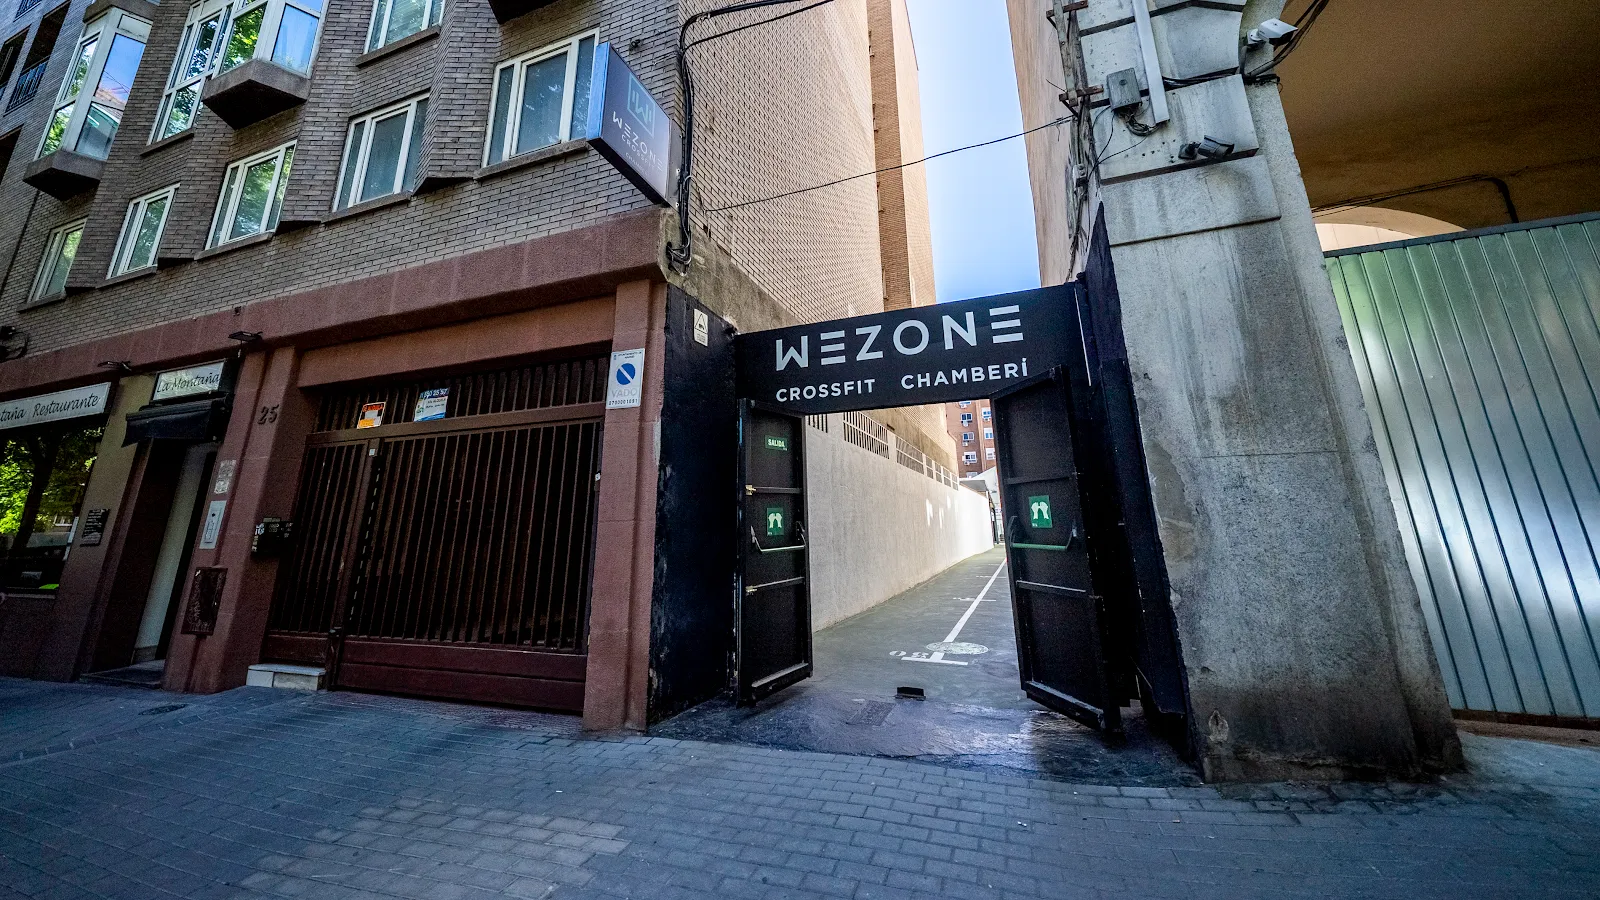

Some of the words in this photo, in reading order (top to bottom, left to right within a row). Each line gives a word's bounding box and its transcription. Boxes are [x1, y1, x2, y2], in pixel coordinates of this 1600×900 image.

[612, 111, 663, 172] WEZONE
[775, 304, 1024, 372] WEZONE
[171, 372, 220, 391] Montaña
[776, 378, 876, 402] CROSSFIT
[611, 388, 638, 398] VADO
[33, 393, 100, 417] Restaurante
[257, 404, 279, 425] 25
[768, 438, 785, 448] SALIDA
